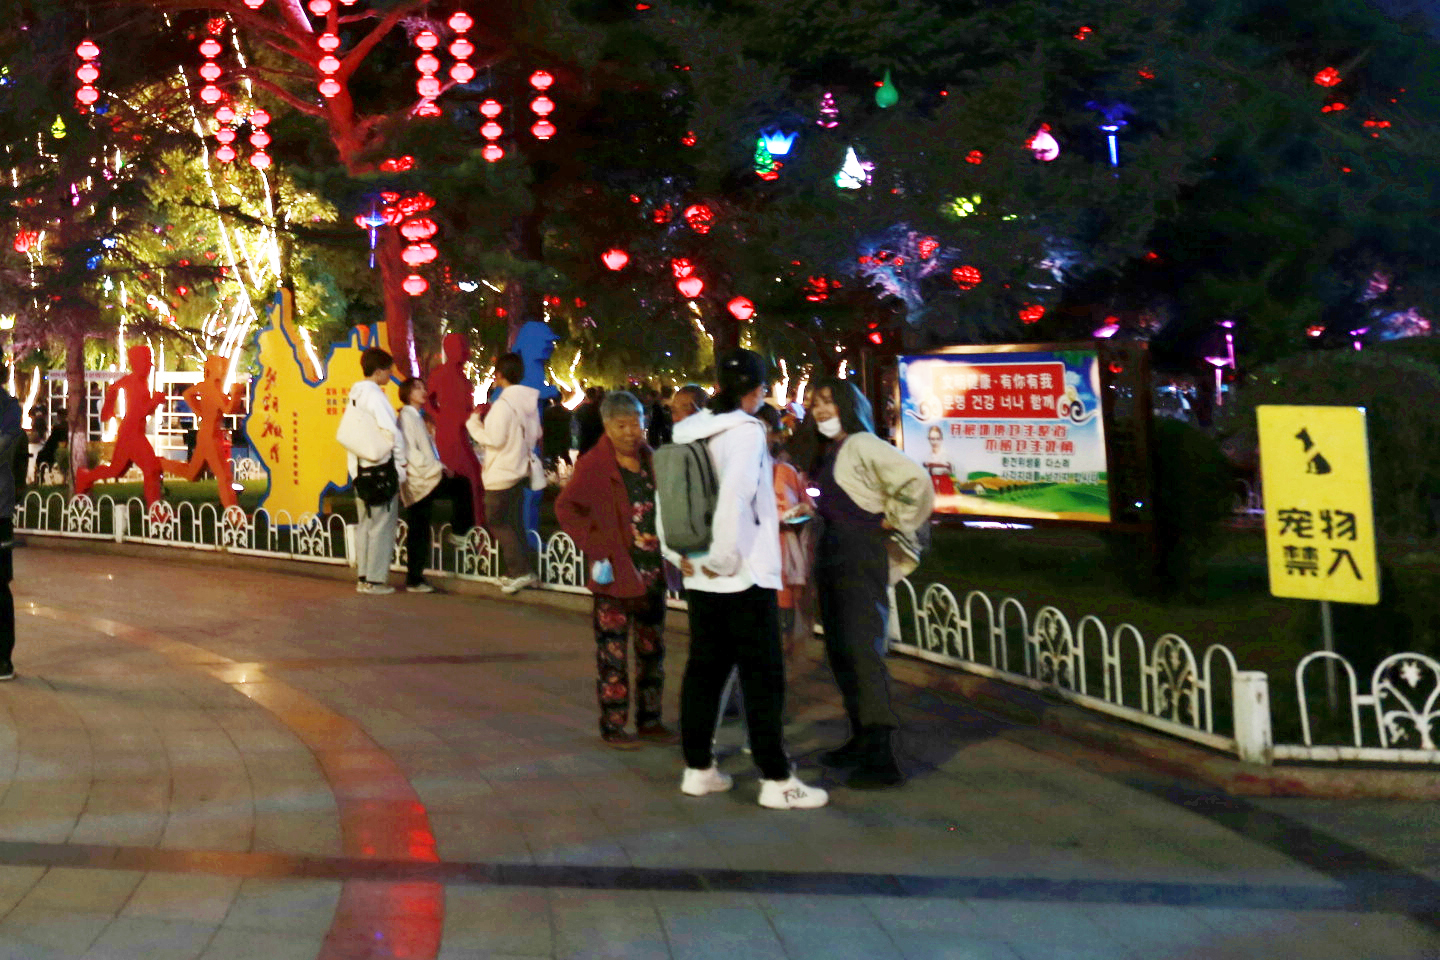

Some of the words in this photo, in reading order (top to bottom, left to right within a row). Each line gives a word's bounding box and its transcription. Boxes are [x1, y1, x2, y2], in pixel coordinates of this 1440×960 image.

[972, 394, 995, 410] 건강
[1000, 394, 1024, 410] 너나
[1030, 394, 1056, 410] 함께
[1277, 507, 1358, 541] 宠物
[1282, 545, 1364, 581] 禁入
